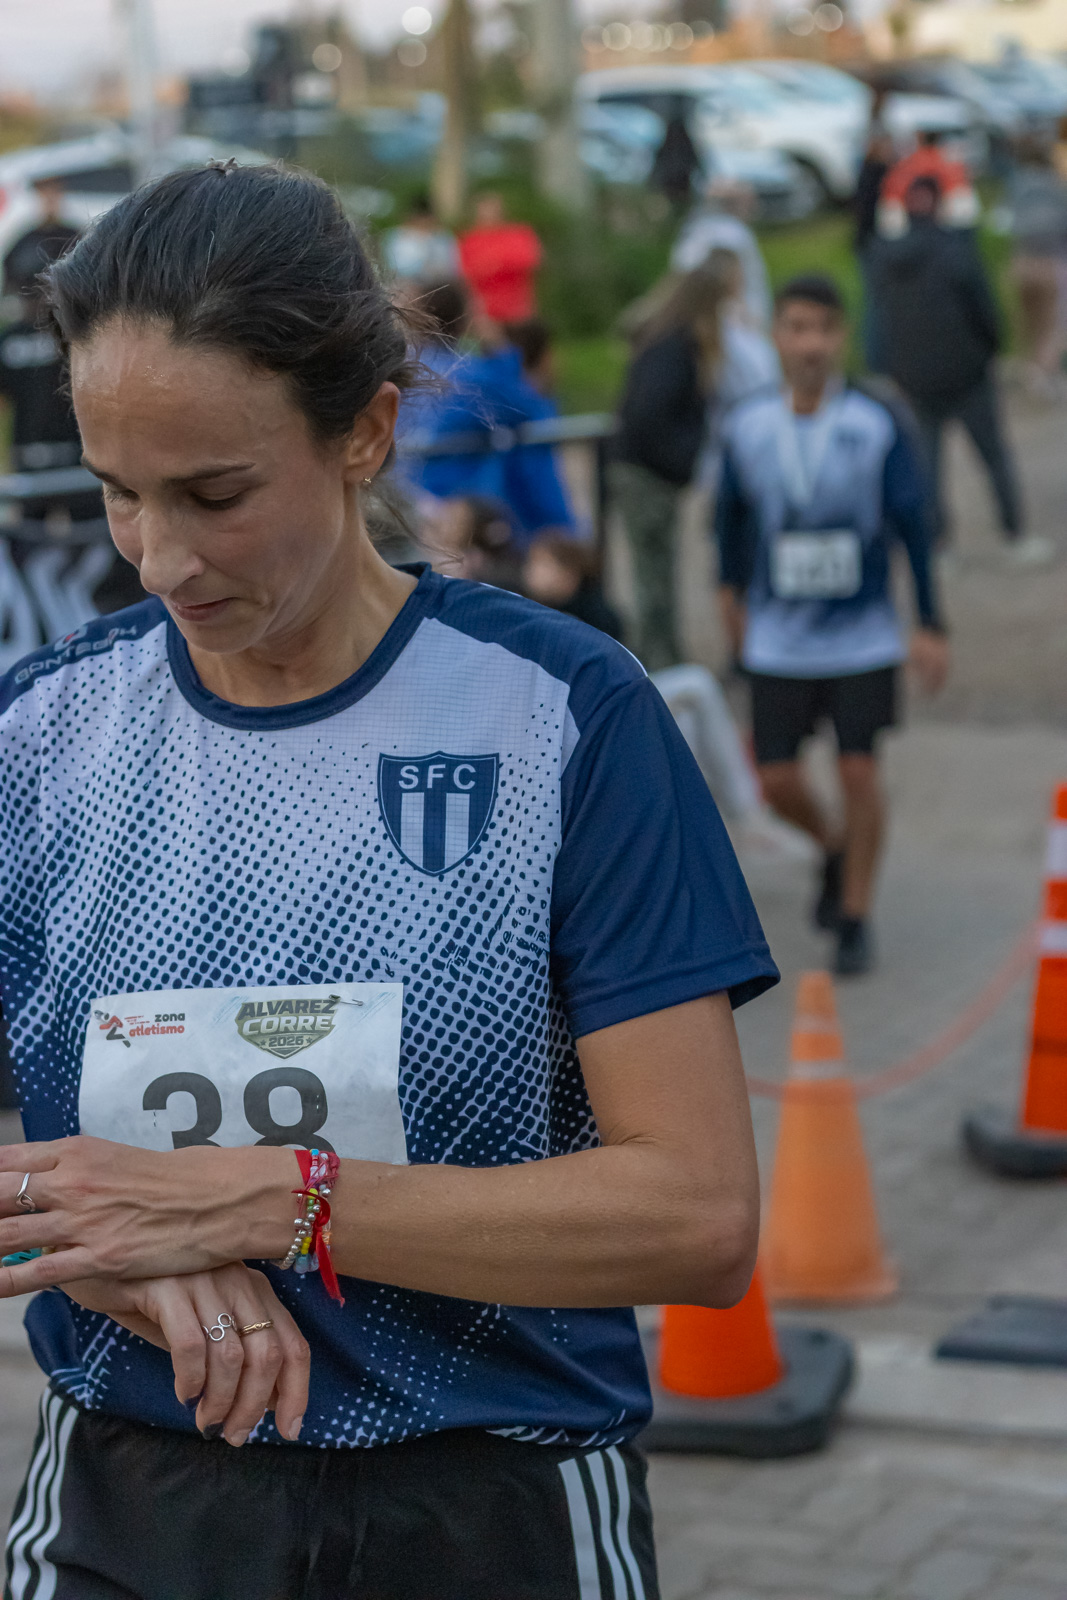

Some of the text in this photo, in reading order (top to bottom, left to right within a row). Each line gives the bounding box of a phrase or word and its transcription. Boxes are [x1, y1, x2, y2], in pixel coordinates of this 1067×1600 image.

[398, 763, 476, 790] SFC
[154, 1012, 186, 1023] zona
[238, 999, 335, 1020] ALVAREZ
[128, 1022, 185, 1037] atletismo
[242, 1015, 331, 1036] CORRE
[268, 1035, 304, 1048] 2026
[142, 1066, 335, 1154] 38
